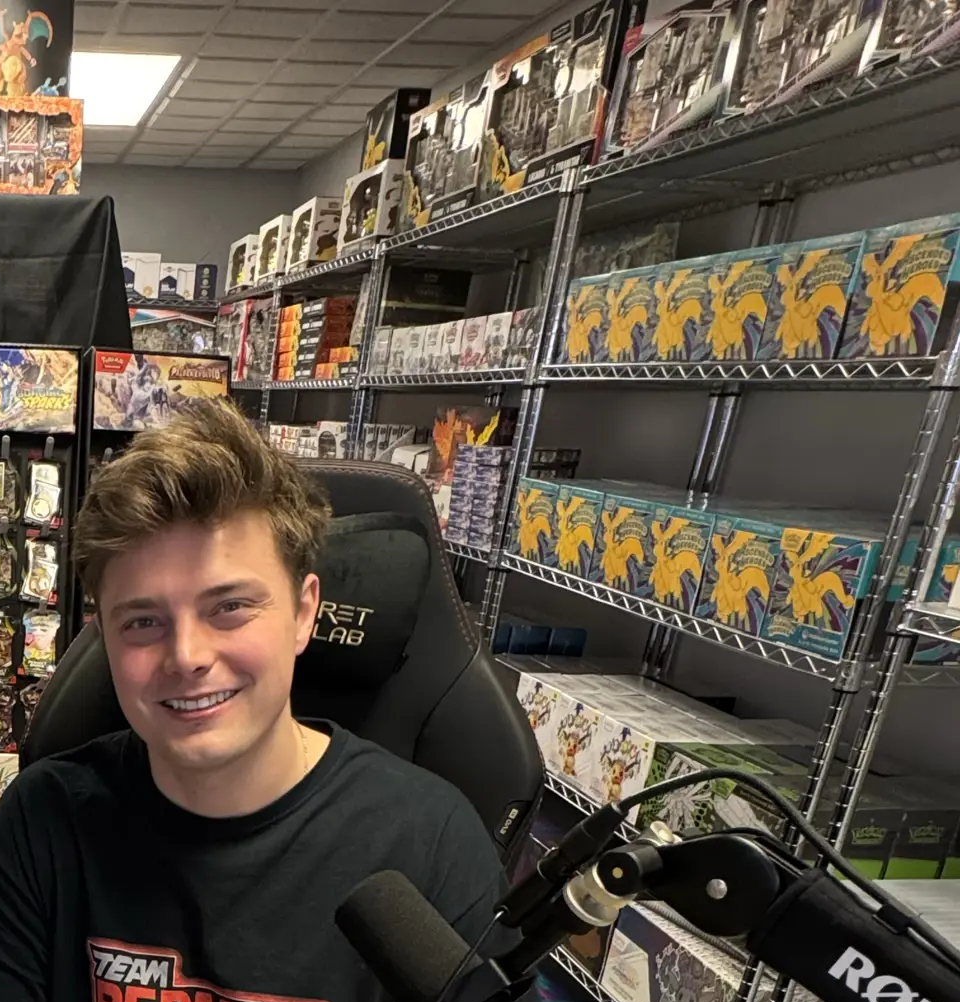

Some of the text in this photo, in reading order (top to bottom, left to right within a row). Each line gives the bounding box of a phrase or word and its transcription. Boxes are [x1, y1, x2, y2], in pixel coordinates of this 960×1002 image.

[318, 601, 374, 626] RET
[312, 623, 364, 646] LAB
[93, 949, 169, 987] TEAM
